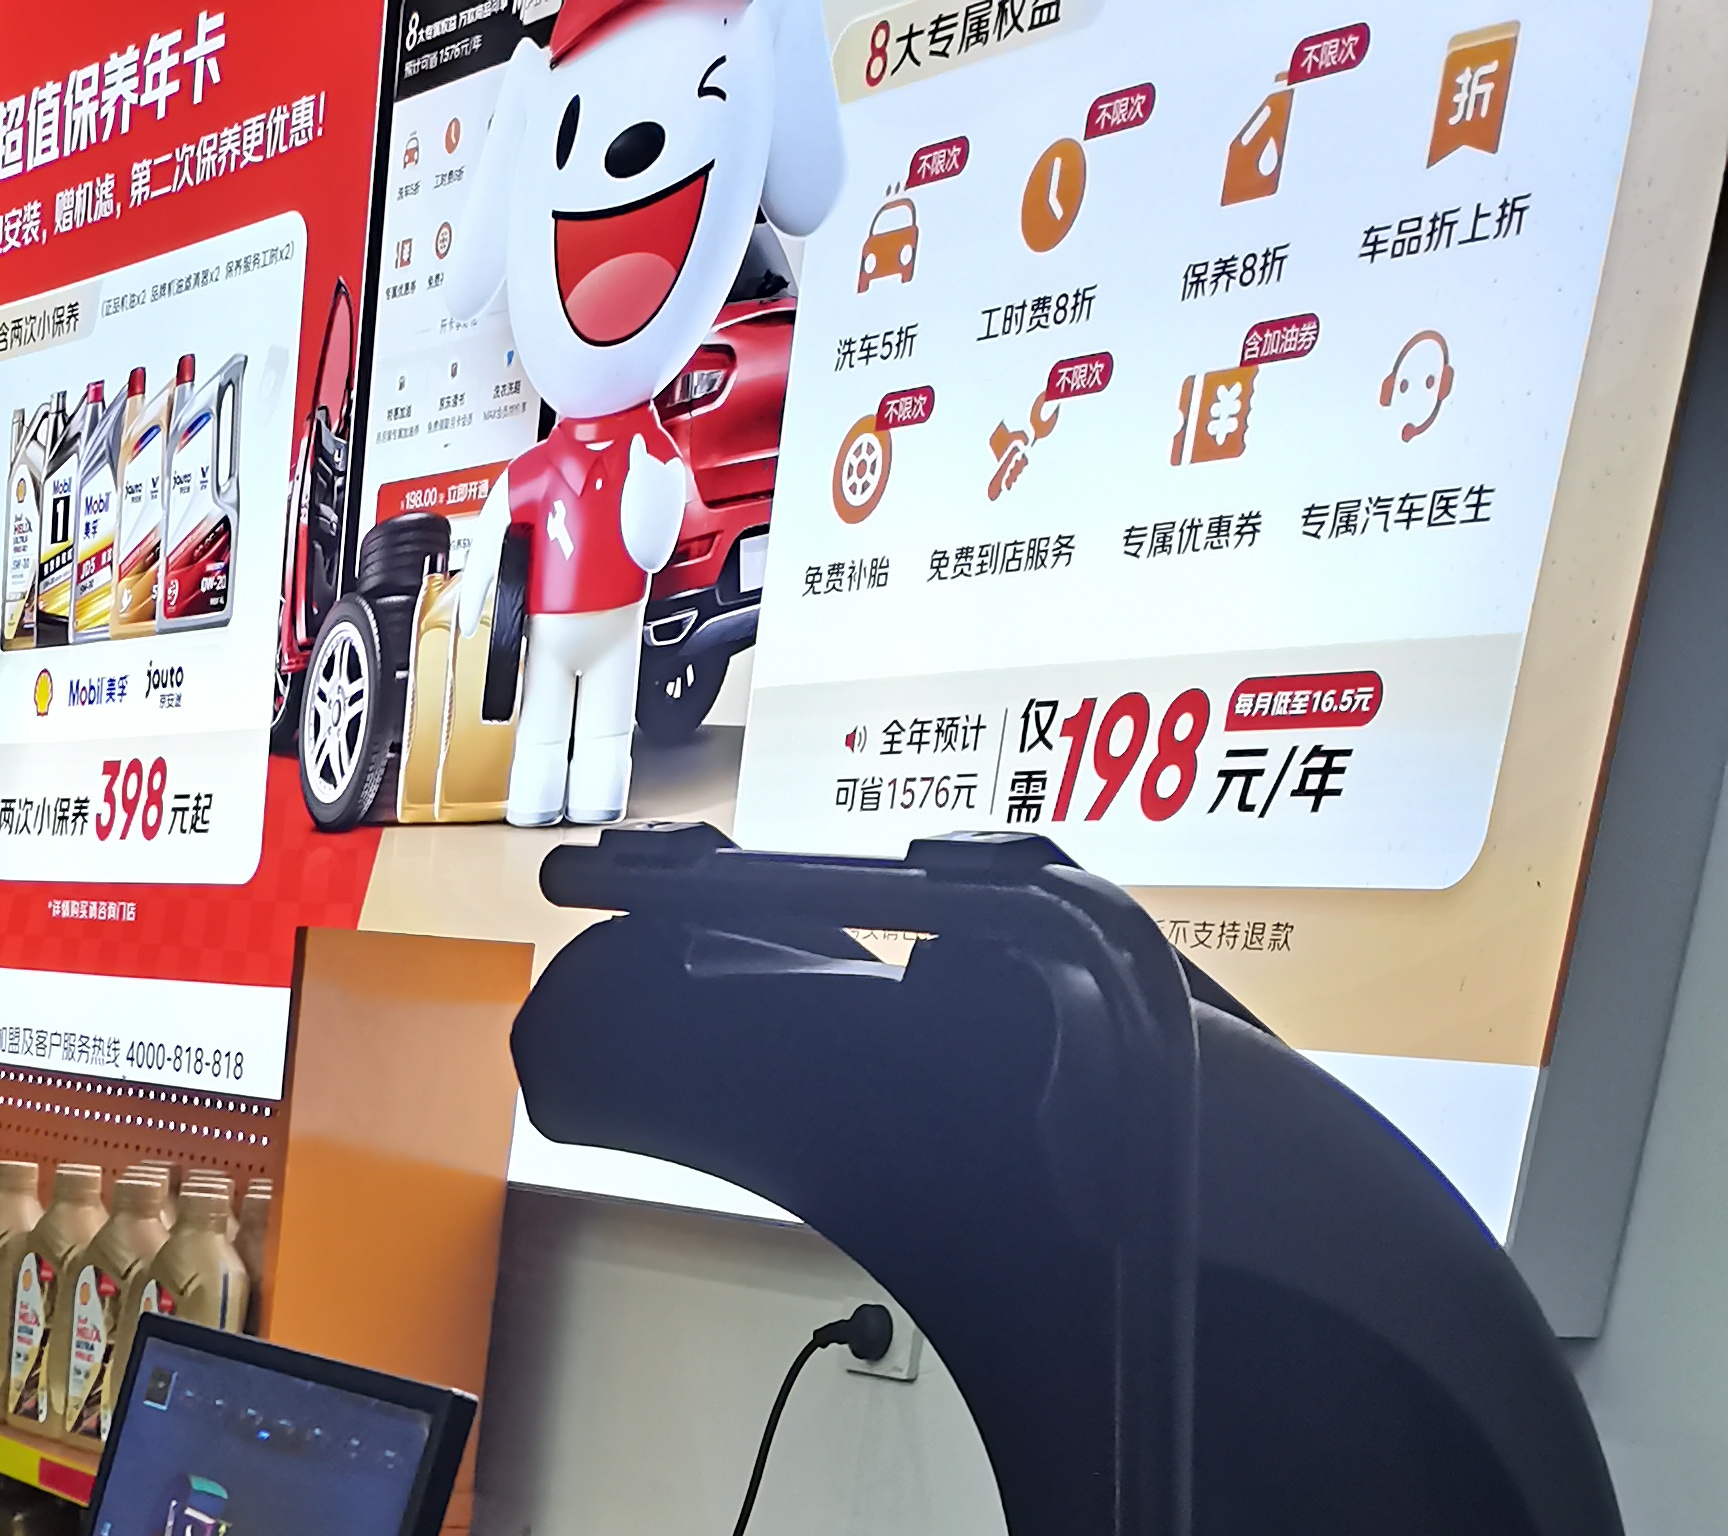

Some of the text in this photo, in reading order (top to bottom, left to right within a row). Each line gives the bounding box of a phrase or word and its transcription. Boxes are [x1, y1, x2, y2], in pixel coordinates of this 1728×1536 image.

[865, 0, 1061, 88] 8大专属权益
[1300, 35, 1360, 74] 不限次
[1096, 93, 1147, 130] 不限次
[1449, 67, 1495, 123] 折
[915, 144, 964, 179] 不限次
[1358, 193, 1534, 264] 车品折上折
[1182, 243, 1291, 304] 保养8折
[978, 285, 1099, 343] 工时费8折
[834, 323, 921, 373] 洗车5折
[1243, 320, 1319, 364] 含加油券
[1054, 361, 1106, 394] 不限次
[883, 392, 929, 425] 不限次
[1300, 484, 1495, 541] 专属汽车医生
[1122, 510, 1263, 561] 专属优惠券
[802, 554, 890, 599] 免费补胎
[927, 533, 1077, 585] 免费到店服务
[68, 675, 130, 707] Mobil 美孚
[1233, 685, 1375, 721] 每月低至16.5元
[879, 714, 987, 757] 全年预计
[1052, 688, 1212, 823] 198
[95, 755, 167, 841] 398
[168, 792, 213, 835] 元起
[834, 773, 978, 814] 可省1576元
[1207, 744, 1354, 816] 元/年
[1156, 918, 1296, 952] 不支持退款
[125, 1040, 245, 1082] 4000-818-818
